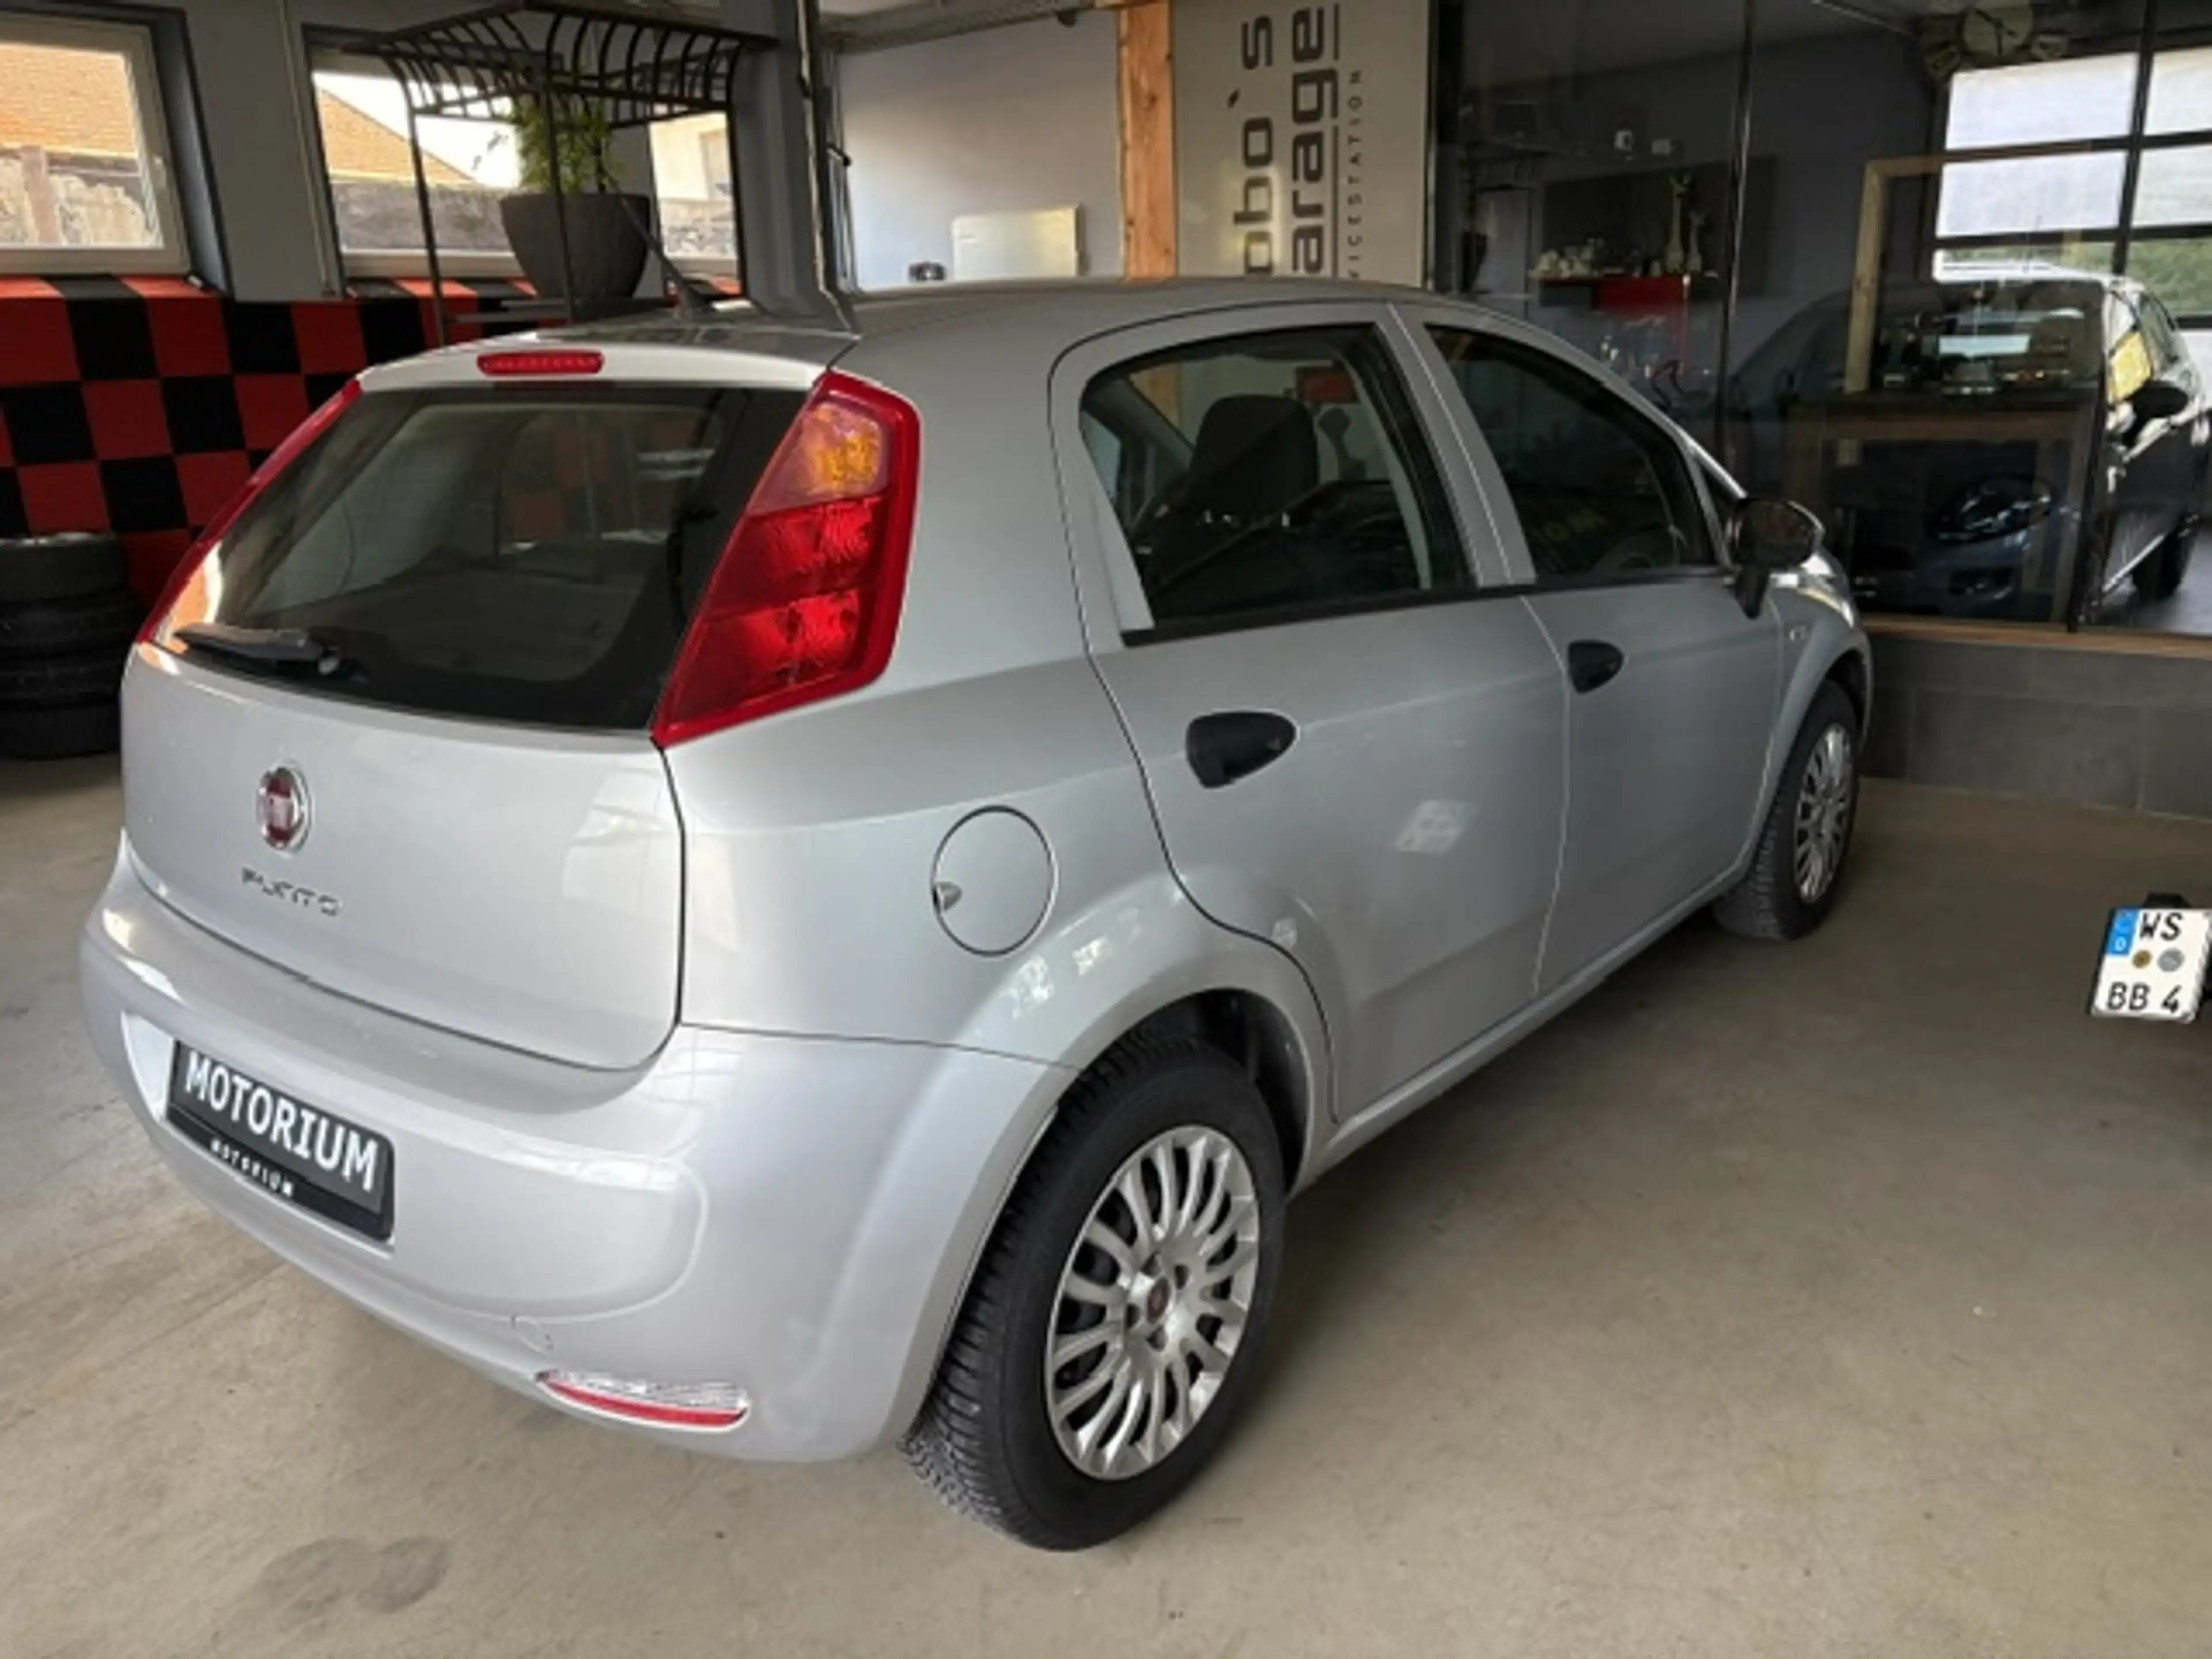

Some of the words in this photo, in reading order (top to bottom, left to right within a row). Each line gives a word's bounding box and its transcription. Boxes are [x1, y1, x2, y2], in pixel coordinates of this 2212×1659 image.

[1292, 7, 1339, 274] arage
[2139, 912, 2183, 941] WS
[2107, 981, 2151, 1010] BB
[2161, 985, 2182, 1013] 4
[185, 1050, 378, 1192] MOTORIUM
